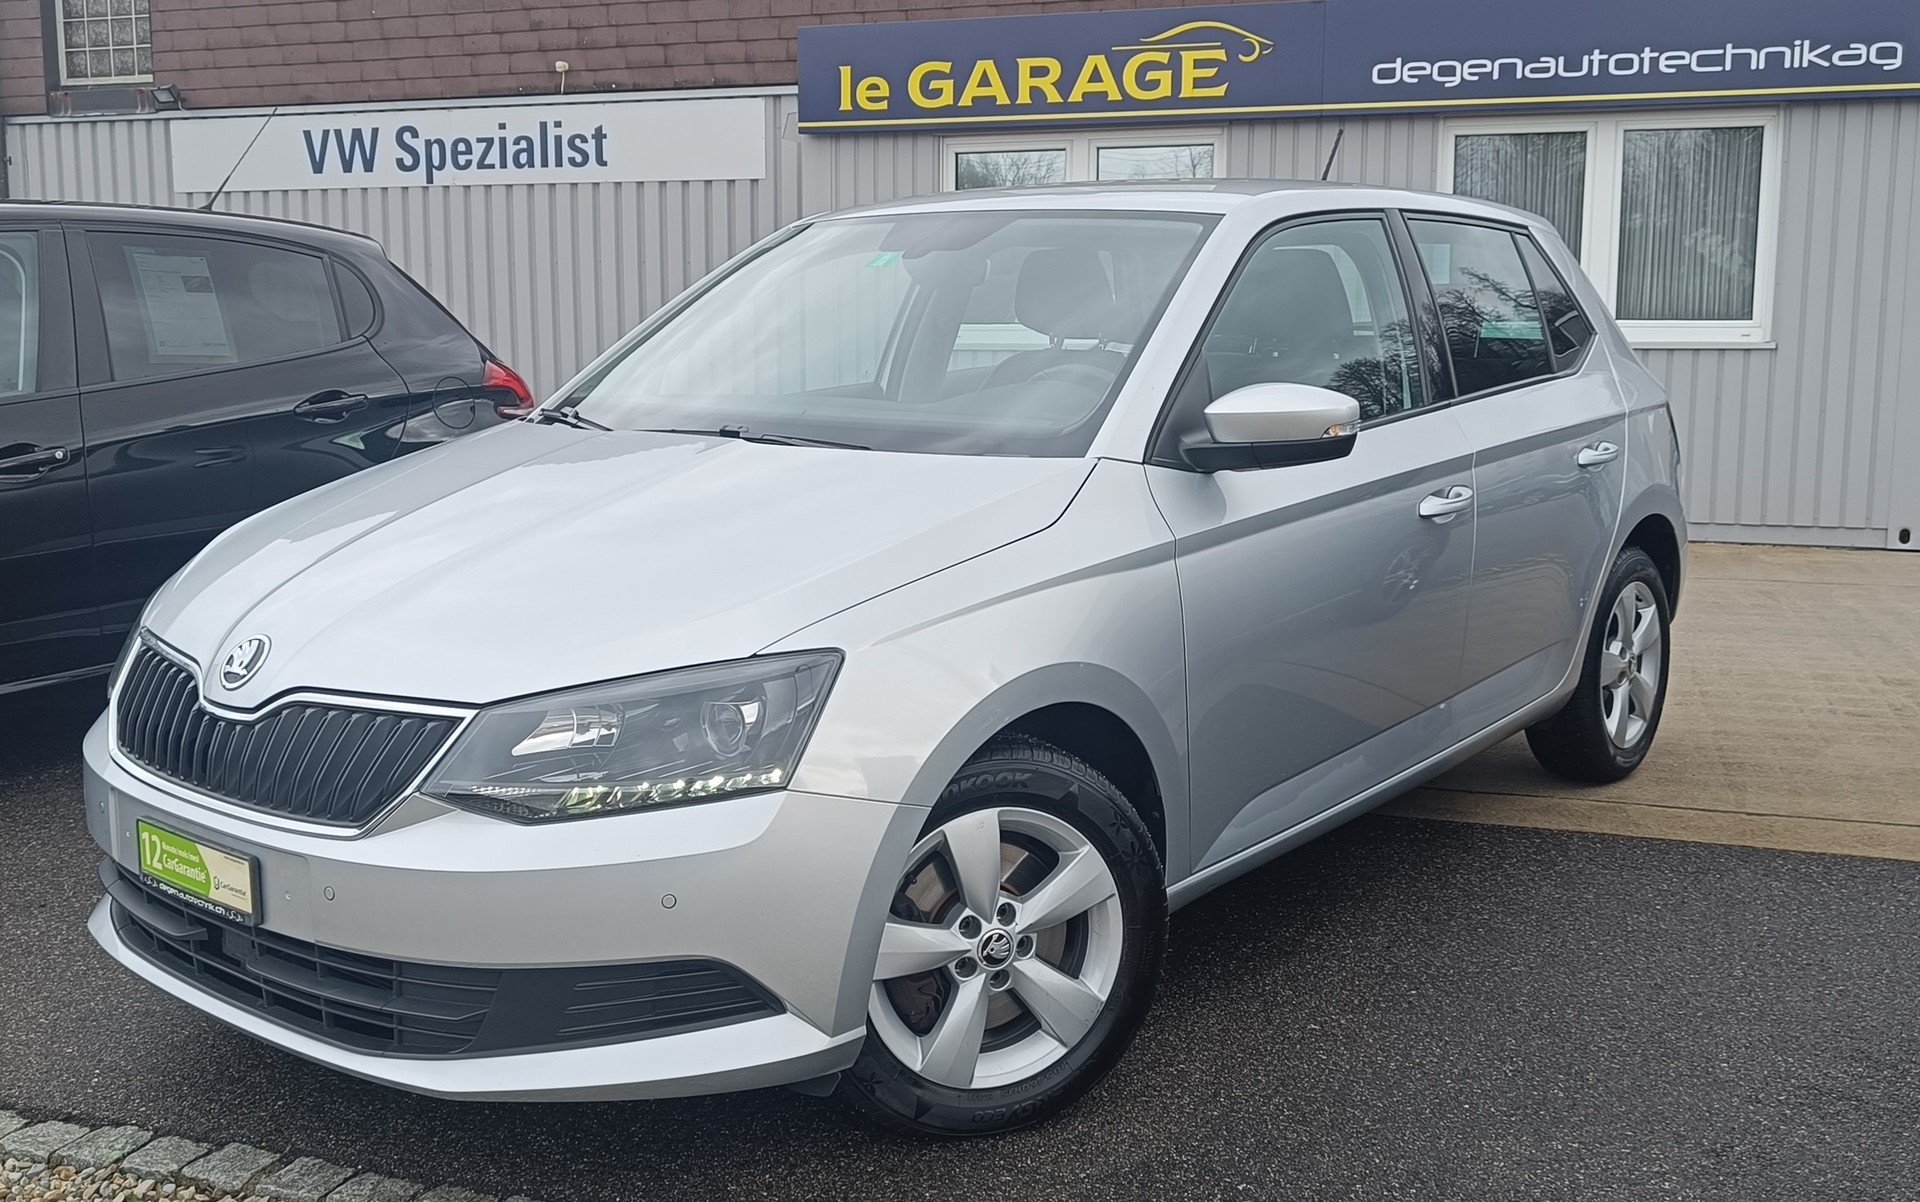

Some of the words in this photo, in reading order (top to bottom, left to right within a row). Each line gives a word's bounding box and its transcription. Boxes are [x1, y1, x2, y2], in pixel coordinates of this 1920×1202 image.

[839, 65, 890, 111] le
[907, 49, 1230, 109] GARAGE
[302, 127, 380, 175] VW
[395, 120, 608, 184] Spezialist
[142, 831, 163, 870] 12
[163, 853, 206, 883] CarGarantie
